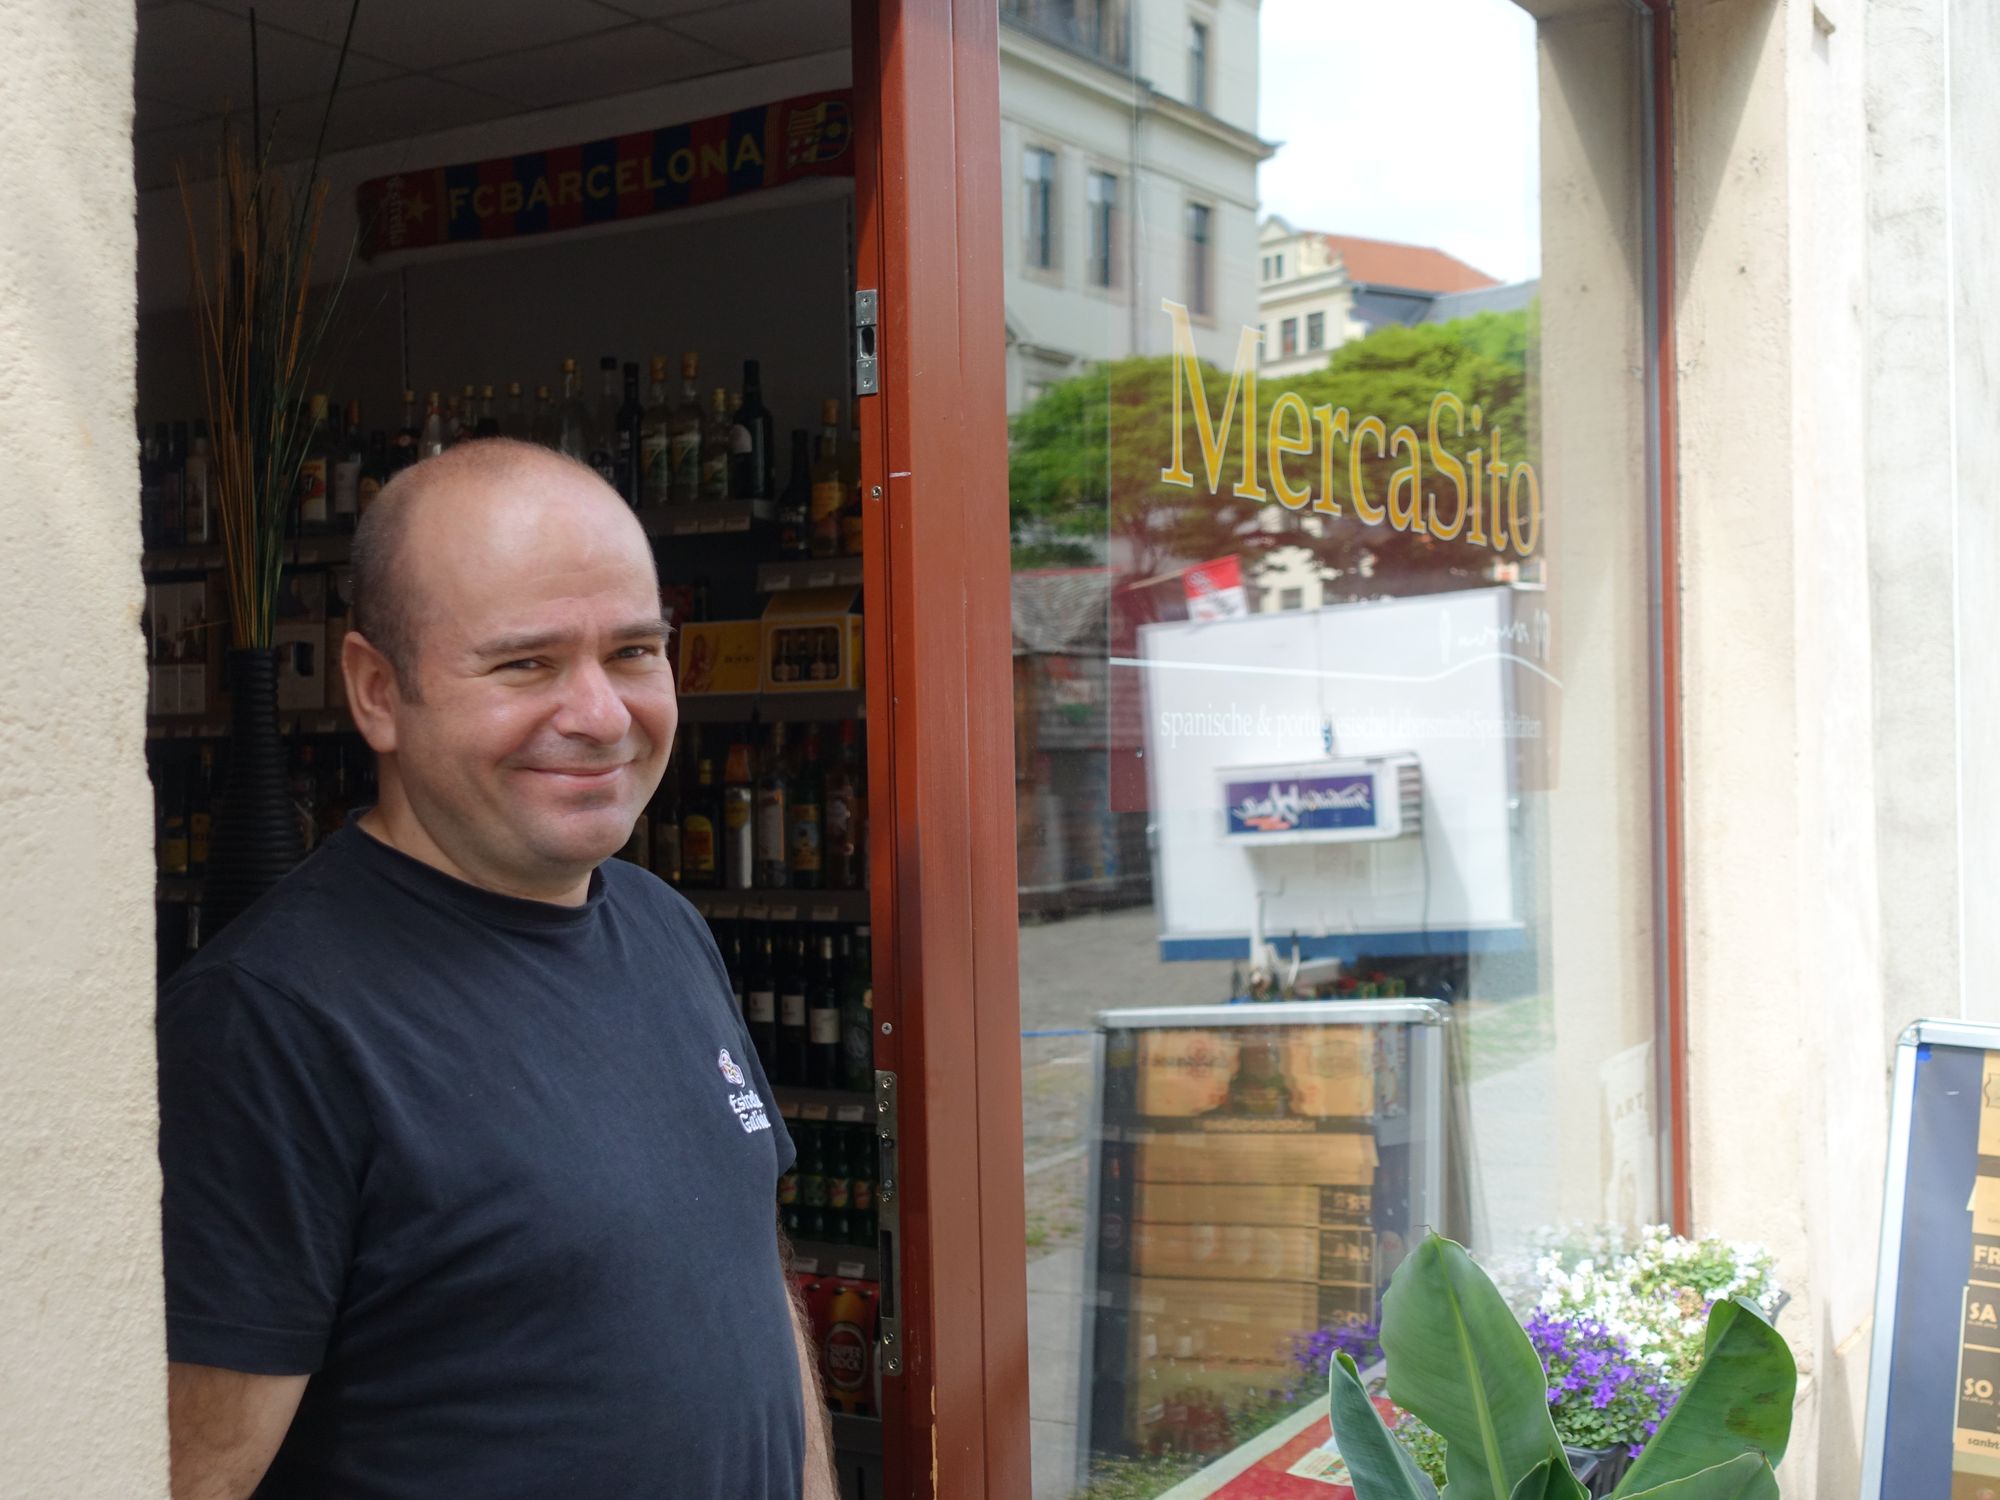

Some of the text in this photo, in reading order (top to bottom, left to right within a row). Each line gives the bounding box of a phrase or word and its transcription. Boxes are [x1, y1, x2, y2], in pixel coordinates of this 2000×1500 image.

[1161, 298, 1541, 557] MercaSito
[1160, 702, 1254, 749] spanische
[1257, 703, 1273, 737] &
[1969, 1302, 1997, 1323] SA
[1964, 1377, 1993, 1399] SO
